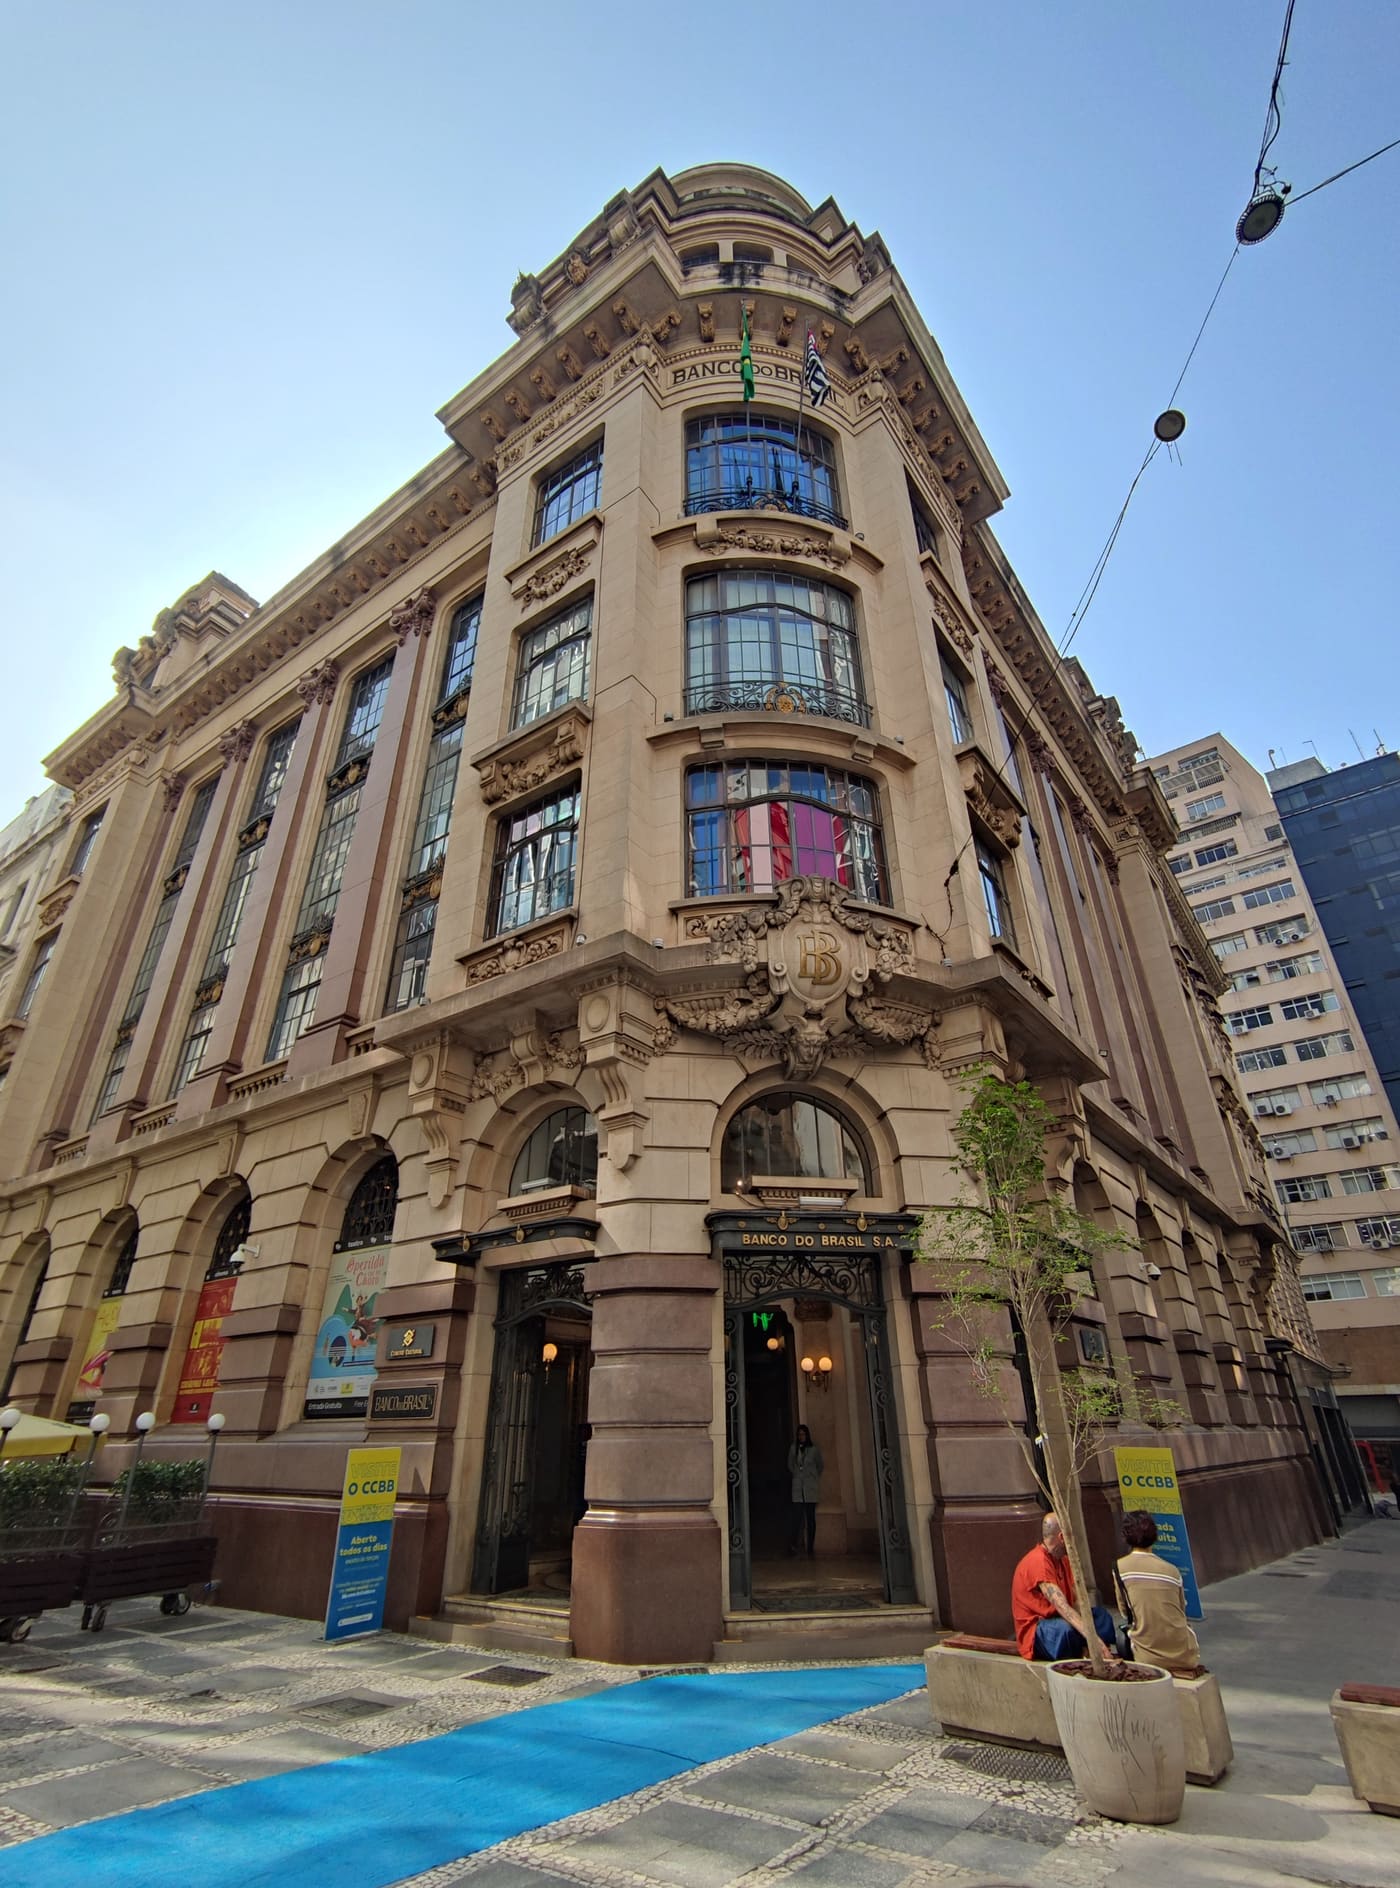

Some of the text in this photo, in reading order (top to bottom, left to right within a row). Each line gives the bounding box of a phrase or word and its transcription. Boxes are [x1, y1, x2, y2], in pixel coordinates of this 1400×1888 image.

[672, 360, 742, 385] BANCO
[742, 1233, 898, 1248] BANCO DO BRASIL S.A.
[375, 1395, 399, 1412] BANCO
[403, 1393, 429, 1411] BRASIL
[351, 1461, 398, 1479] VISITE
[1118, 1459, 1173, 1474] VISITE
[348, 1480, 395, 1496] O CCBB
[1122, 1475, 1174, 1489] O CCBB
[350, 1535, 378, 1546] Aberto
[339, 1543, 388, 1556] todos os dias
